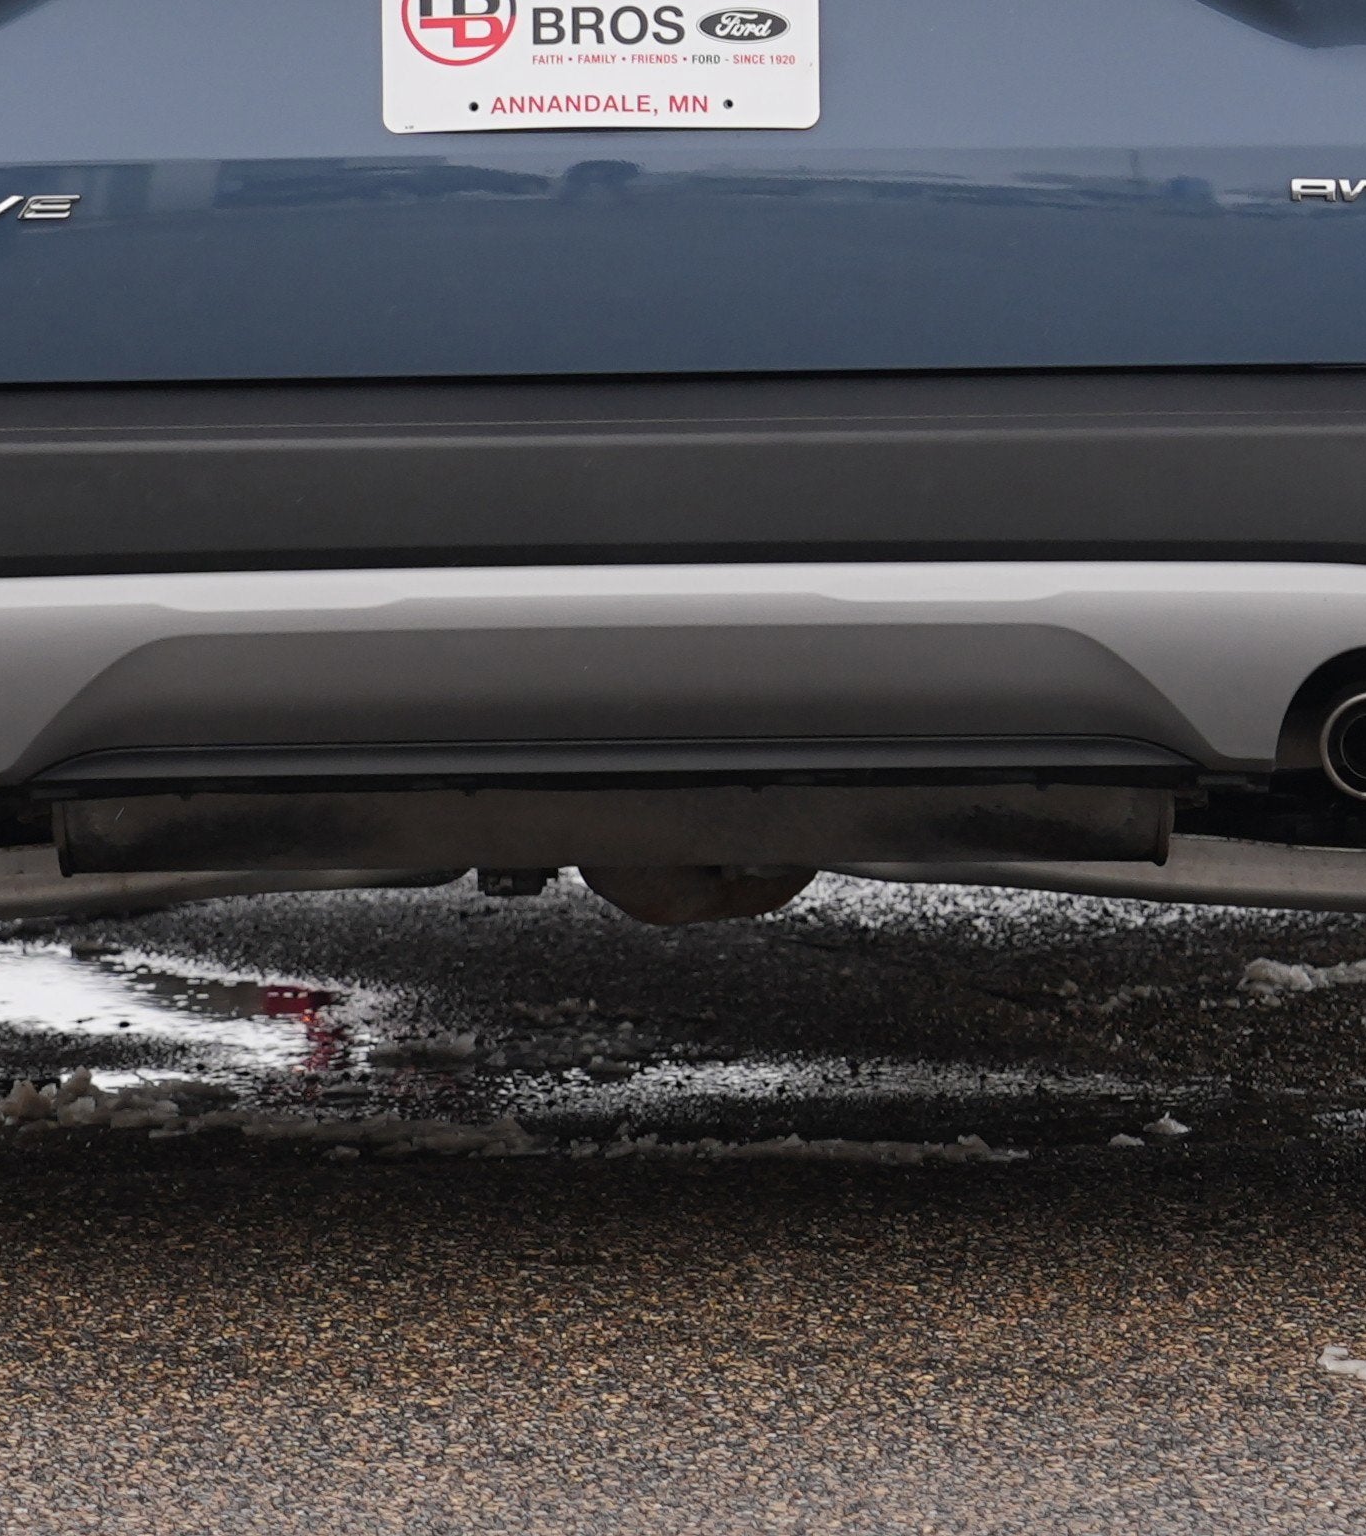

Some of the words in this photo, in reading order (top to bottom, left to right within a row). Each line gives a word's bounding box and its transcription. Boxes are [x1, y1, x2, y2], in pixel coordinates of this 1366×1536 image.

[532, 5, 686, 46] BROS
[715, 11, 772, 39] Ford
[532, 54, 563, 65] FAITH
[577, 53, 617, 65] FAMILY
[631, 53, 678, 64] FRIENDS
[691, 54, 721, 64] FORD
[733, 54, 765, 65] SINCE
[770, 54, 796, 65] 1920
[491, 94, 659, 116] ANNANDALE,
[669, 95, 708, 113] MN
